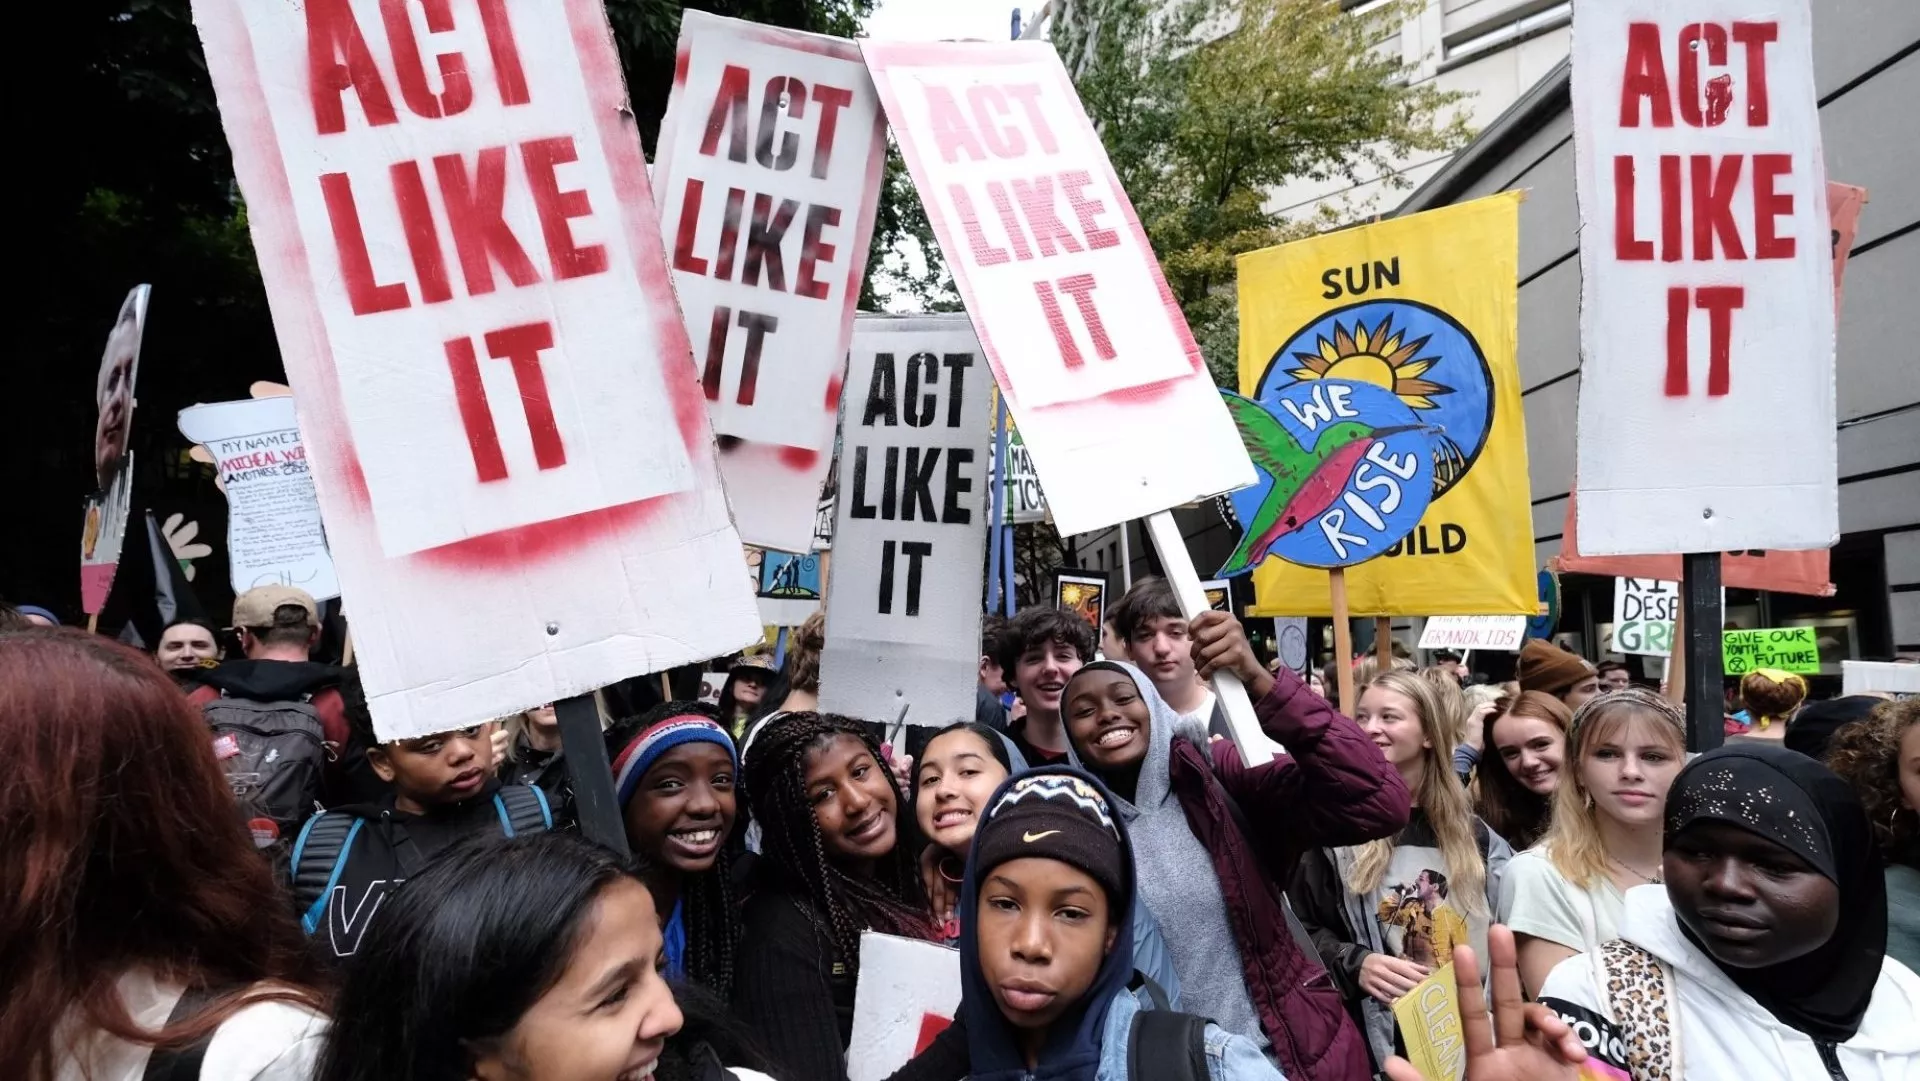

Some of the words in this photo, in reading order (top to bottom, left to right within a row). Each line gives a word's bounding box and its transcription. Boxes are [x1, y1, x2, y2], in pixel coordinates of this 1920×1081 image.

[1619, 22, 1778, 128] ACT
[699, 64, 853, 180] ACT
[924, 84, 1060, 163] ACT
[319, 136, 610, 316] LIKE
[673, 178, 842, 301] LIKE
[947, 170, 1121, 267] LIKE
[1614, 154, 1796, 262] LIKE
[1033, 273, 1118, 370] IT
[1321, 256, 1400, 300] SUN
[702, 306, 779, 406] IT
[1664, 287, 1744, 396] IT
[443, 321, 568, 483] IT
[862, 353, 974, 427] ACT
[1280, 384, 1359, 431] WE
[222, 440, 243, 453] MY
[245, 433, 290, 450] NAME
[850, 446, 974, 525] LIKE
[1319, 440, 1418, 560] RISE
[1386, 523, 1467, 557] ILD
[878, 540, 932, 616] IT
[1724, 631, 1763, 643] GIVE
[1770, 628, 1811, 643] OUR
[1724, 644, 1759, 656] YOUTH
[1754, 650, 1816, 665] FUTURE
